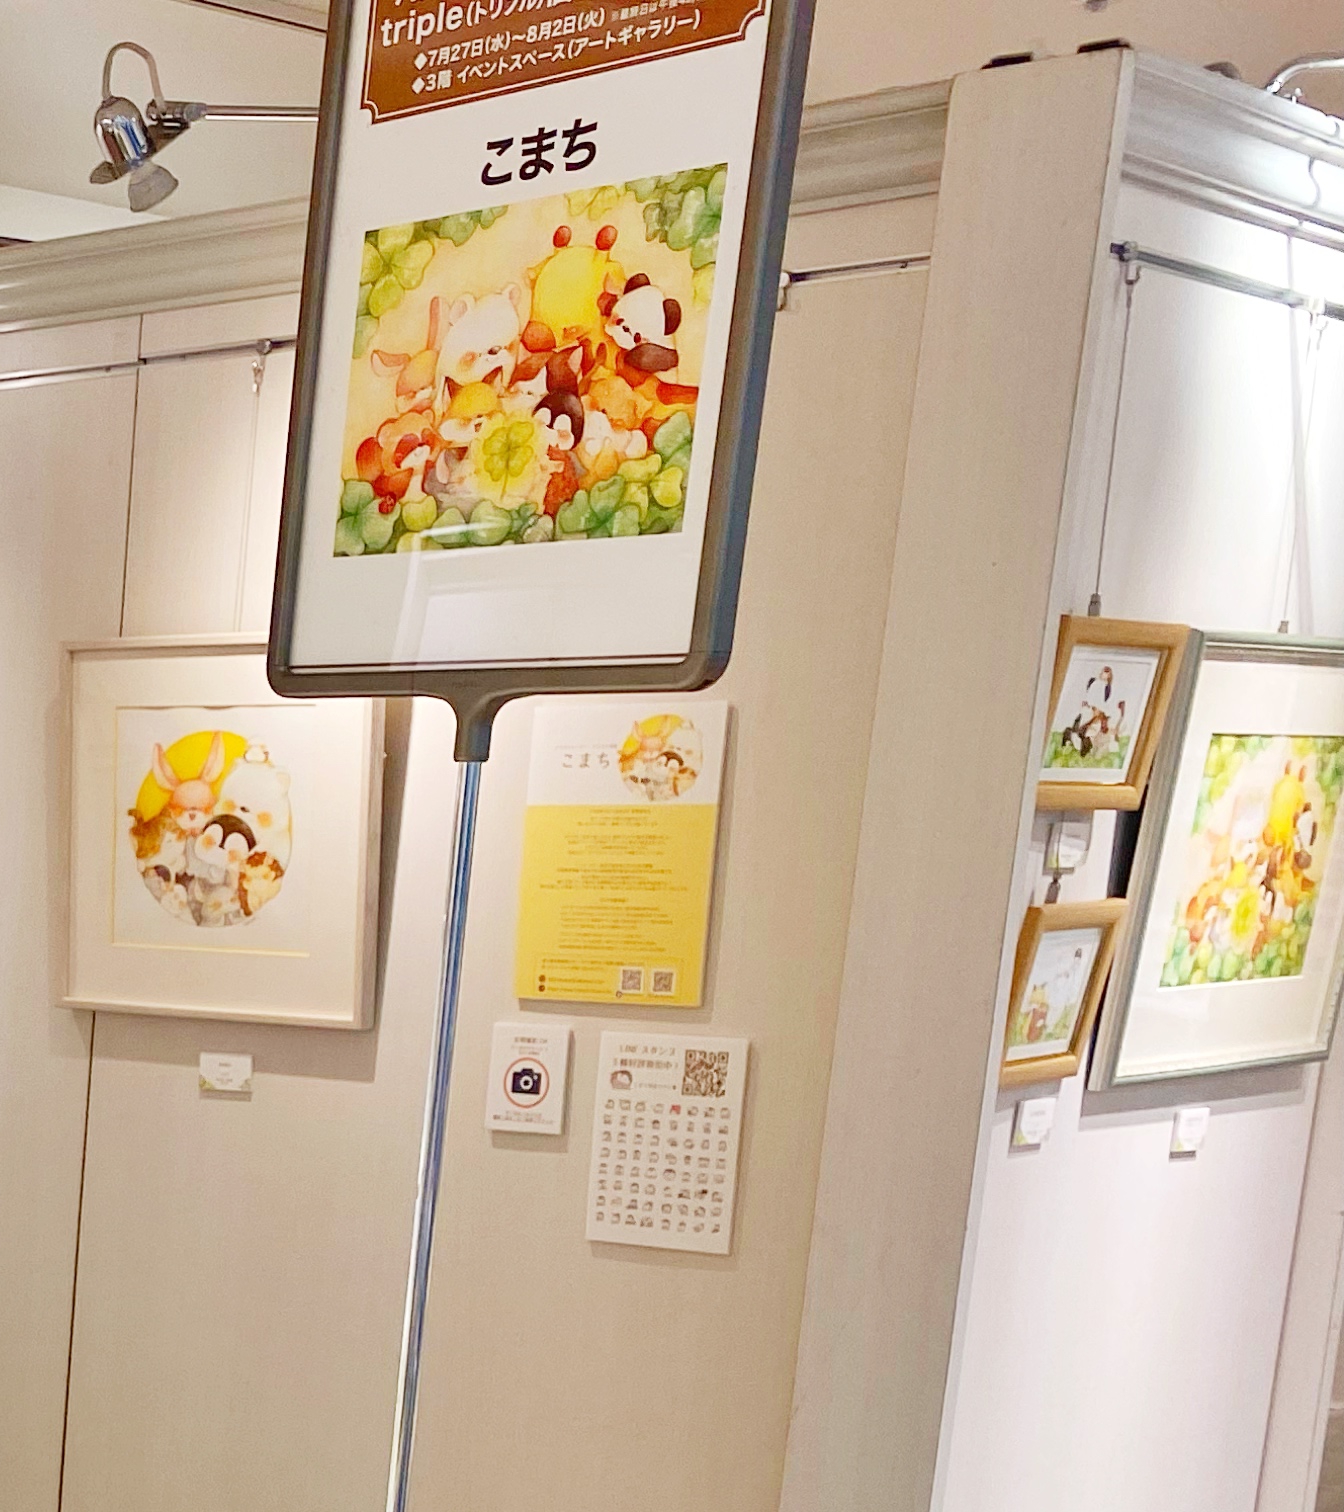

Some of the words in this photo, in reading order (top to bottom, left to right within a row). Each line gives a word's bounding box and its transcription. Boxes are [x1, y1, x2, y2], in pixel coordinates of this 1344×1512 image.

[481, 118, 599, 186] こまち
[562, 752, 610, 769] こまち
